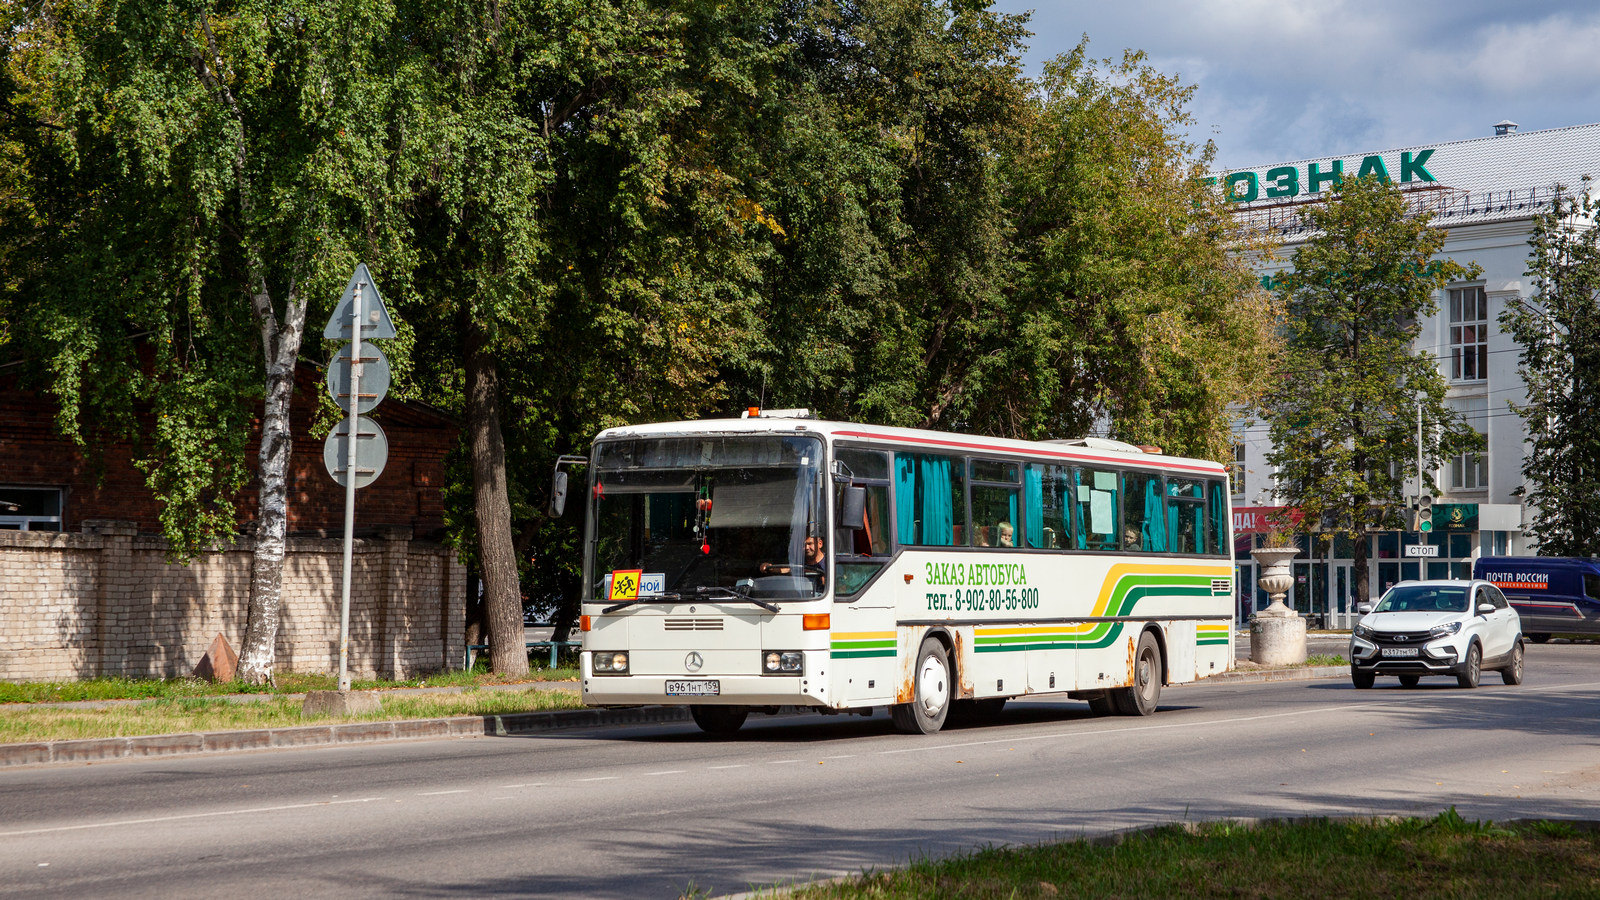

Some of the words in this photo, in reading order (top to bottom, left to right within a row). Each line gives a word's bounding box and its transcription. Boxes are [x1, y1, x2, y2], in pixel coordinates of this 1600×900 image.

[1195, 149, 1437, 204] ОЗНАК
[1410, 546, 1434, 555] СТОП
[926, 562, 965, 585] ЗАКАЗ
[968, 563, 1027, 585] АВТОБУСА
[1486, 572, 1513, 582] ПОЧТА
[1516, 573, 1549, 583] РОССИИ
[640, 580, 660, 591] НОЙ
[926, 593, 953, 611] тел.:
[955, 587, 1039, 611] 8-902-80-56-800
